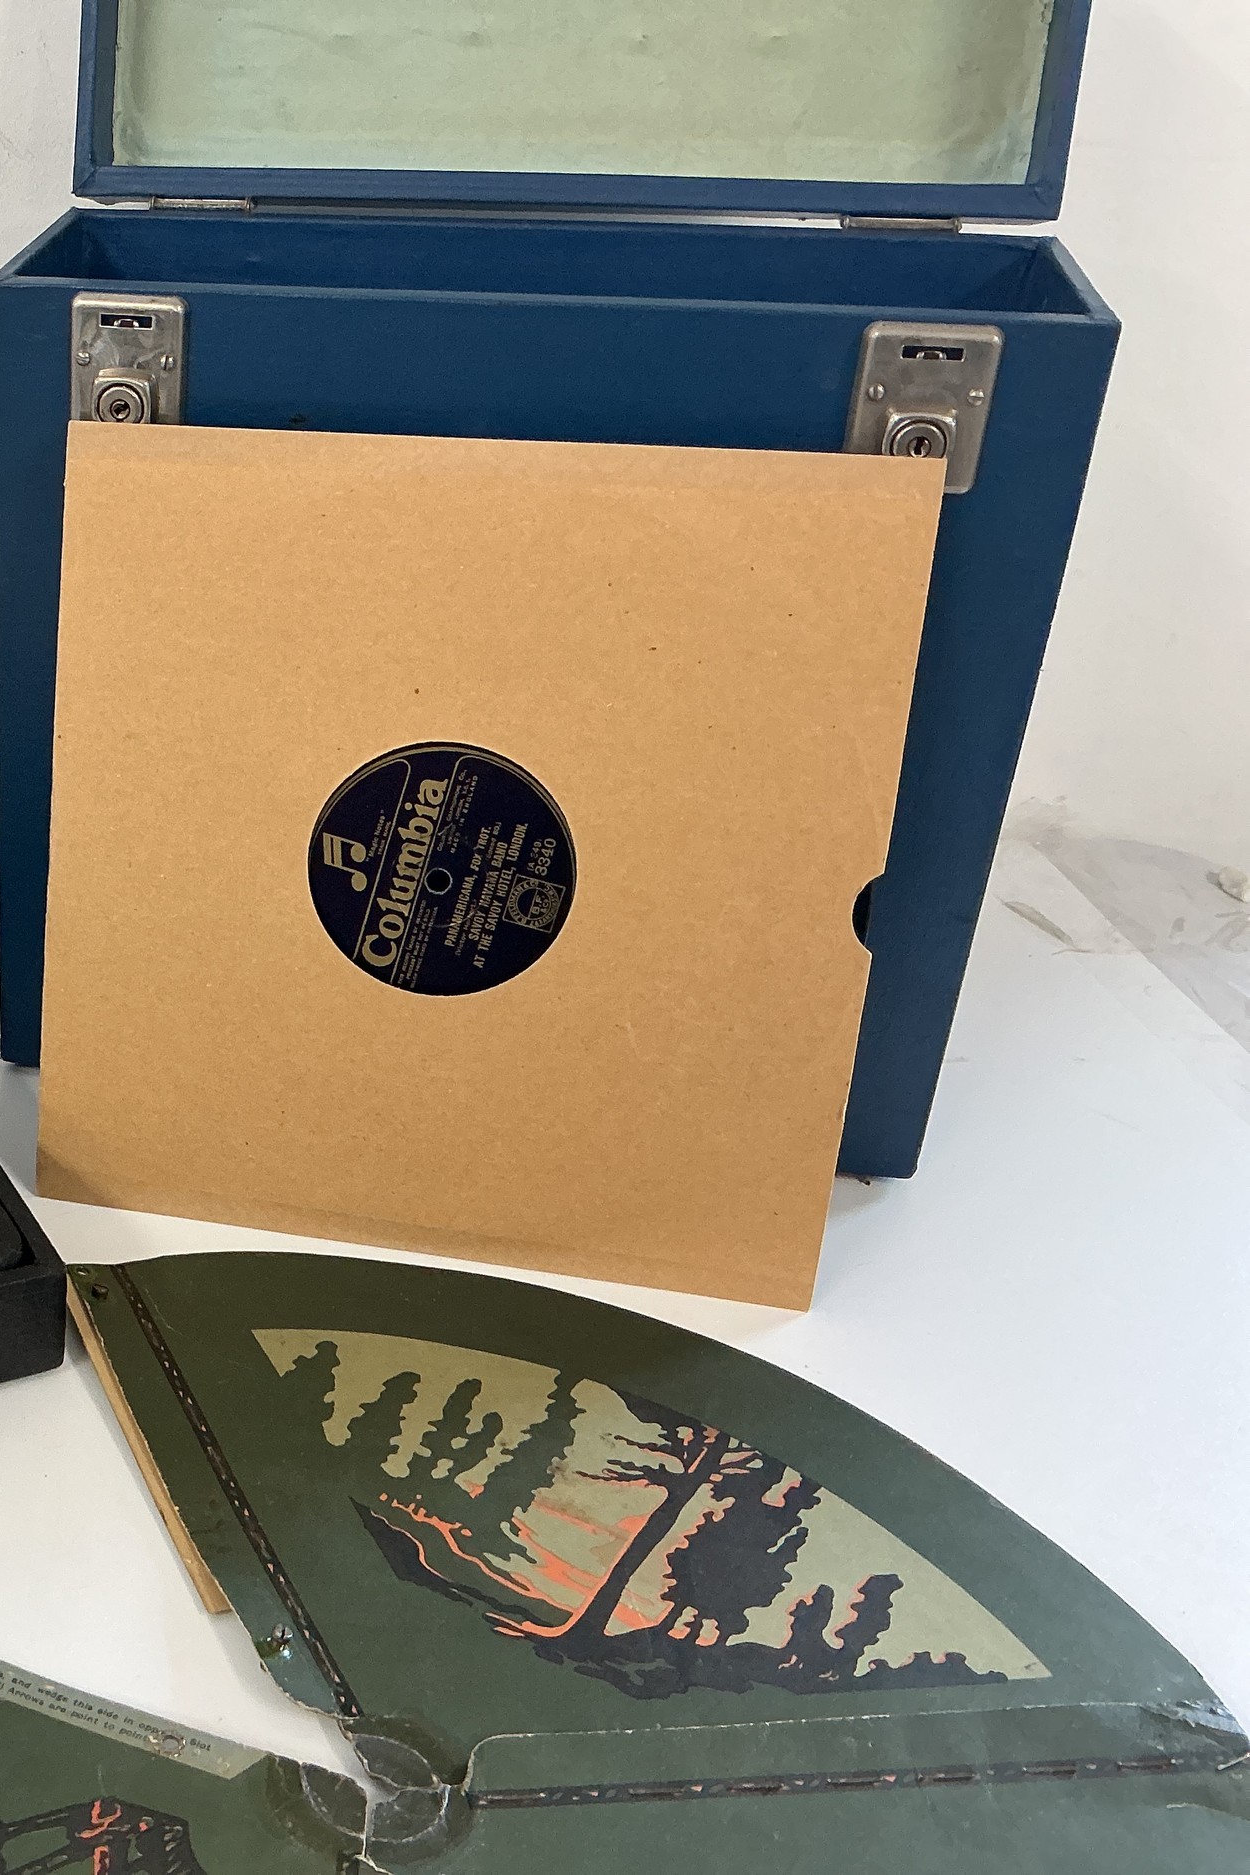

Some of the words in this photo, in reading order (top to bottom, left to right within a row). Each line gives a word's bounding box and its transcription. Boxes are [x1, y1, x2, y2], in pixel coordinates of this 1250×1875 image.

[473, 826, 491, 849] TROT.
[505, 822, 528, 861] LONDON.
[361, 777, 449, 967] Columbia
[469, 852, 482, 871] FOX
[533, 837, 556, 876] 3340
[467, 909, 486, 941] SAVOY
[477, 870, 499, 907] HAVANA
[490, 841, 508, 868] BAND
[495, 866, 516, 897] HOTEL,
[443, 874, 478, 947] PANAMERICANA,
[483, 899, 503, 931] SAVOY
[476, 932, 493, 950] THE
[472, 953, 485, 968] AT
